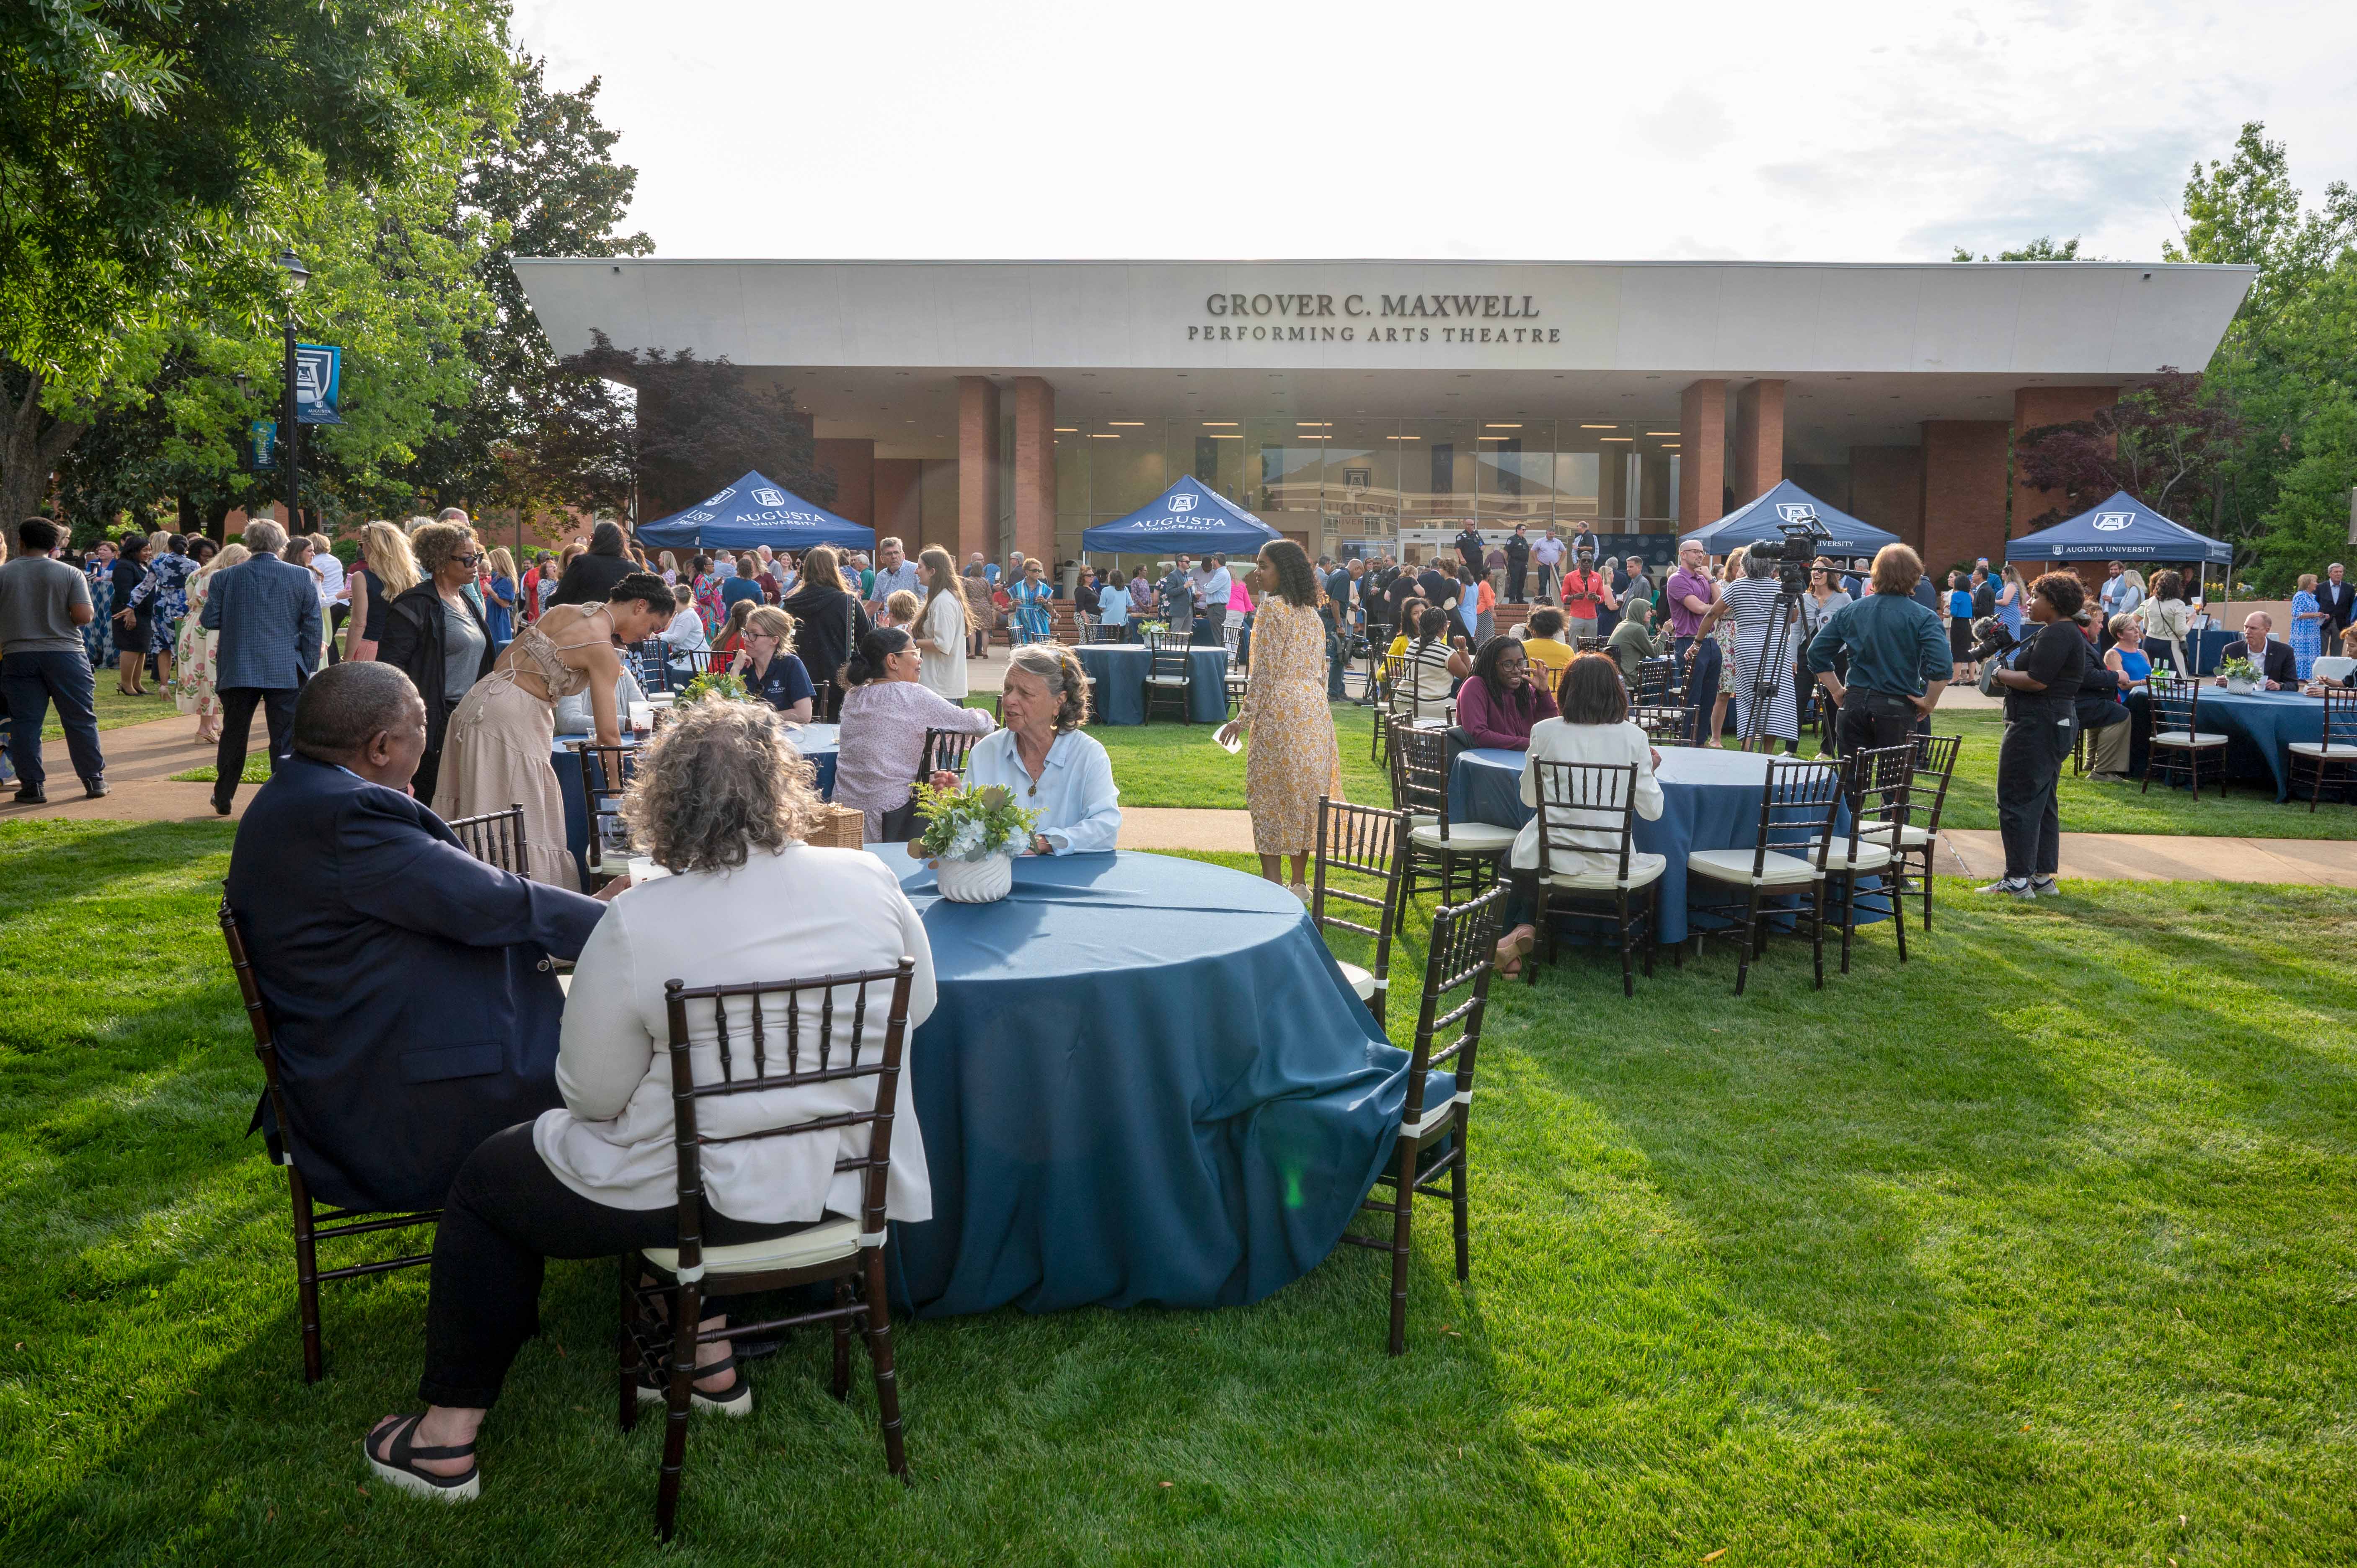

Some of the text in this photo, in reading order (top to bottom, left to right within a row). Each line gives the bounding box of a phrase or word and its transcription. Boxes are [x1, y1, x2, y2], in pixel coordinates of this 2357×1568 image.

[1207, 294, 1540, 317] GROVER C. MAXWELL
[1188, 326, 1560, 342] PERFORMING ARTS THEATRE
[736, 510, 826, 522] AUGUSTA
[1131, 516, 1226, 527] AUGUSTA
